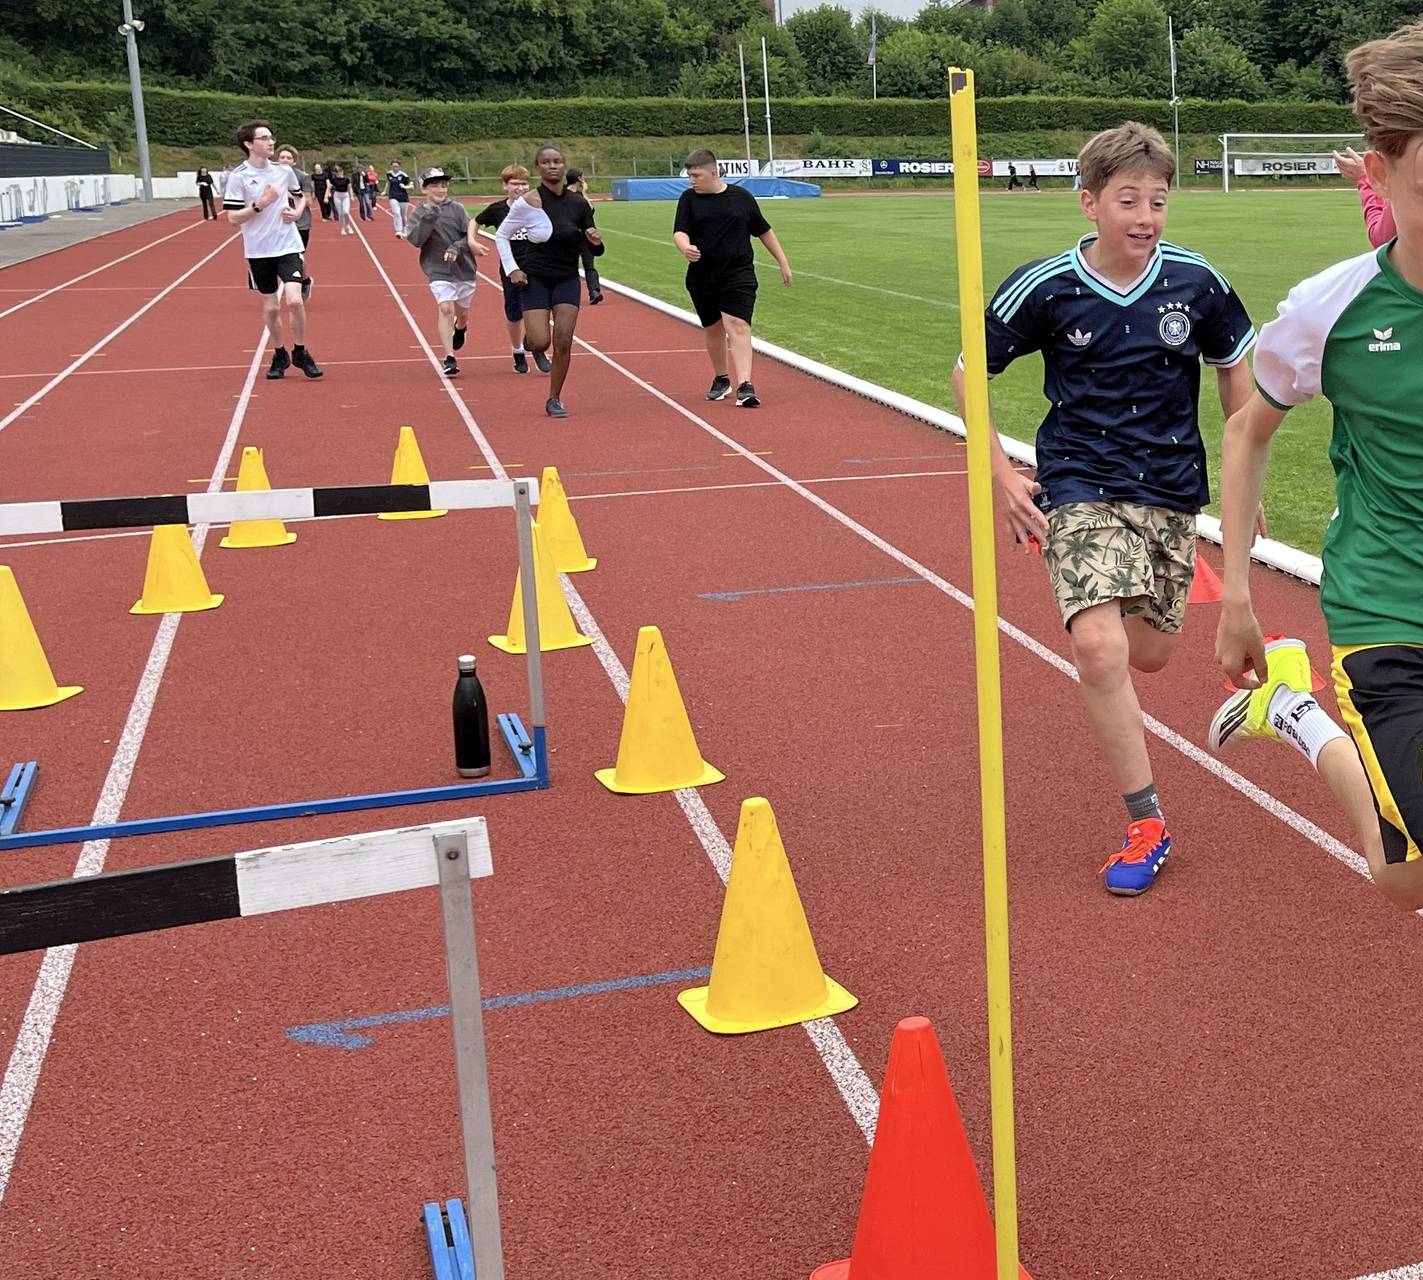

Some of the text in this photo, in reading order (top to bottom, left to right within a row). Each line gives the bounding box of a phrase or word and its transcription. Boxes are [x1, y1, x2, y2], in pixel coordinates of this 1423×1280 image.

[802, 160, 856, 169] BAHR
[900, 162, 955, 173] ROSIER
[1262, 162, 1316, 172] ROSIER
[1368, 341, 1401, 352] erima
